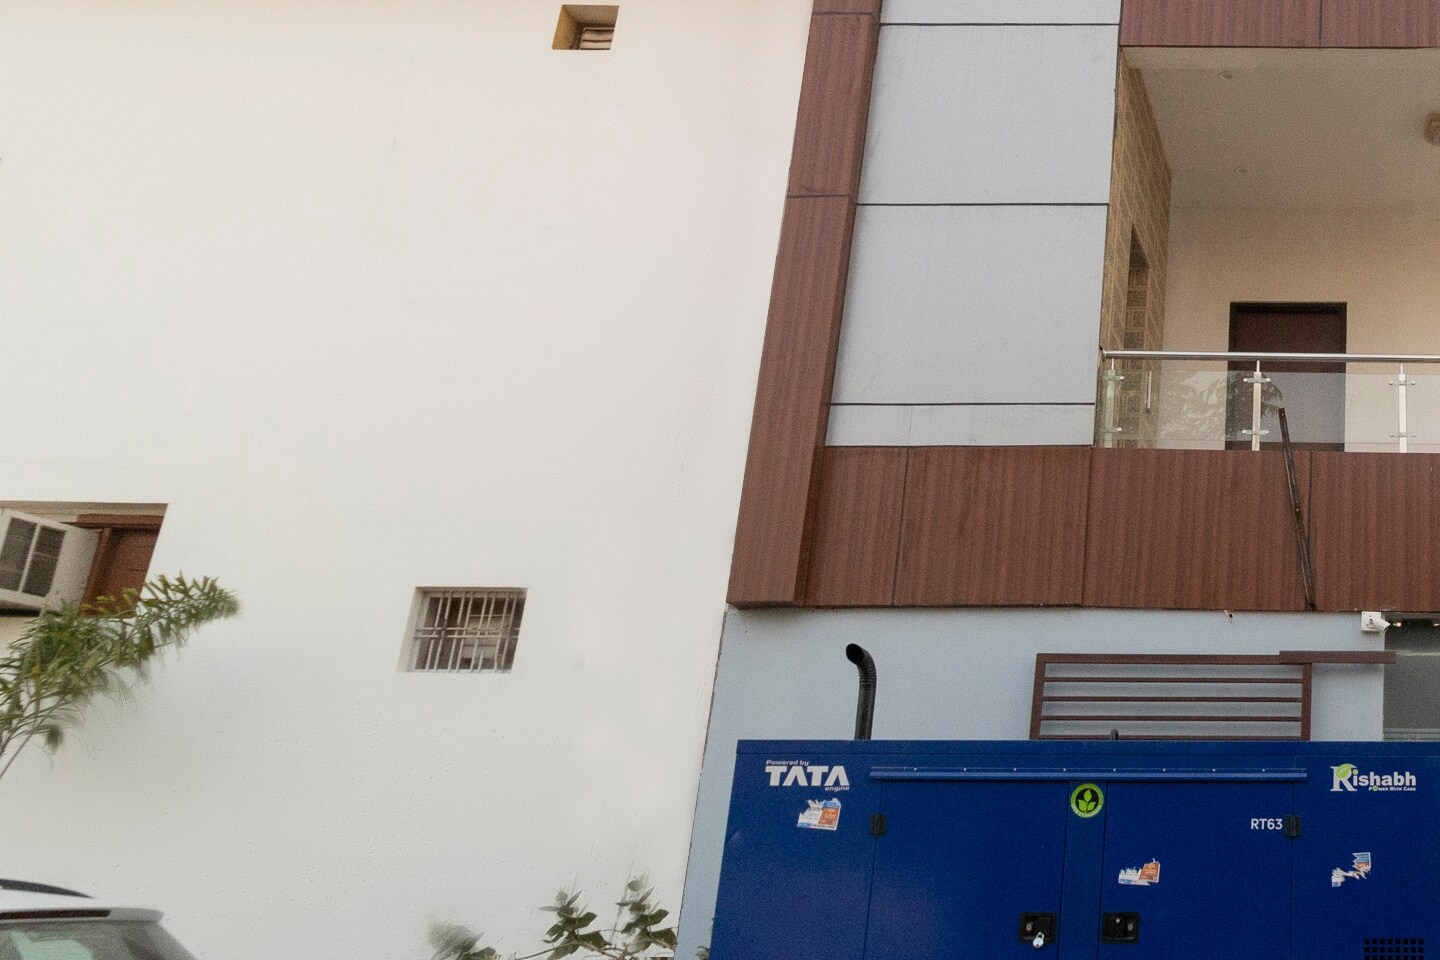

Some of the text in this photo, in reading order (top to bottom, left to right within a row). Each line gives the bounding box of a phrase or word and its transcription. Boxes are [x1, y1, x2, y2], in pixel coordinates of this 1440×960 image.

[800, 759, 809, 767] by
[765, 765, 850, 787] TATA
[1329, 763, 1417, 792] Rishabh
[1251, 818, 1283, 830] RT63
